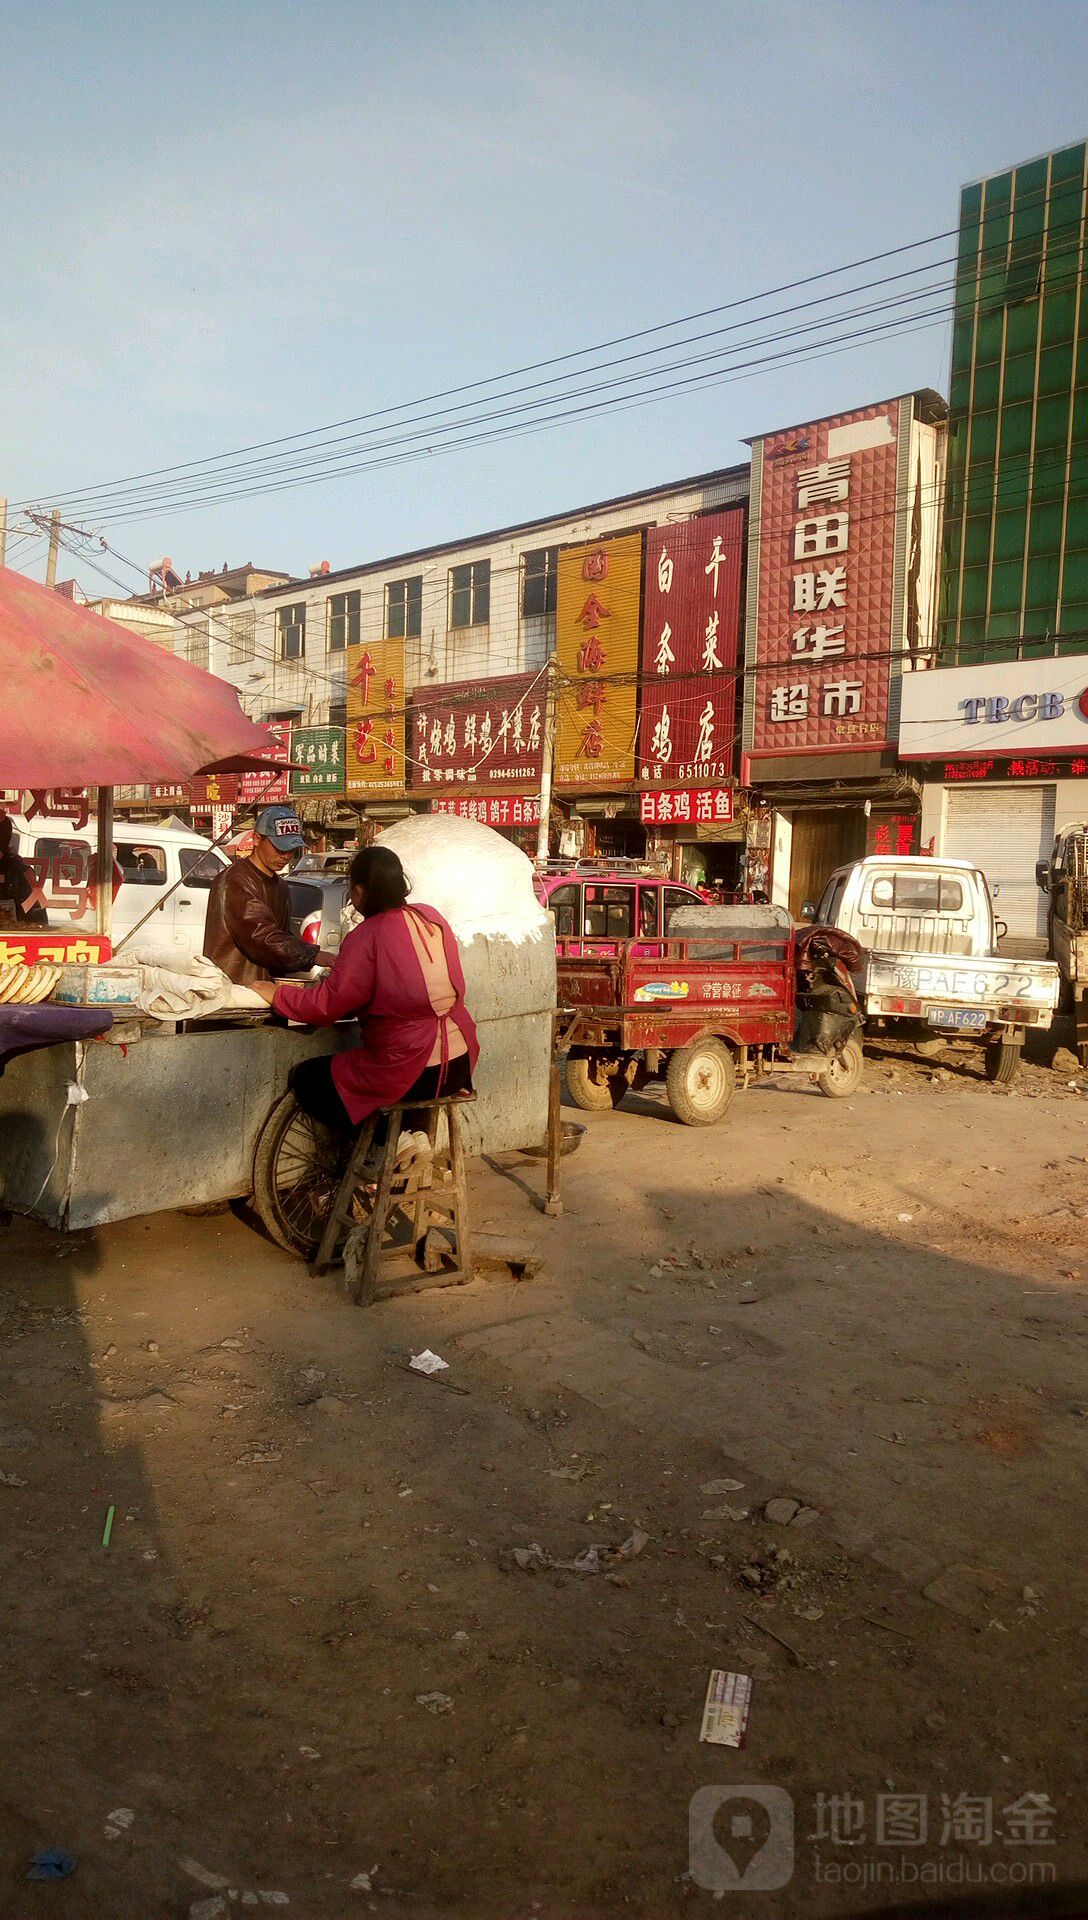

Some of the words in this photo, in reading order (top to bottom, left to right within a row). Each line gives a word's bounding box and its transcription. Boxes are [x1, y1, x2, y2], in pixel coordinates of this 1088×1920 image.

[792, 459, 852, 664] 青田联华
[651, 545, 675, 763] 白条鸡
[694, 535, 726, 763] 干菜店
[771, 679, 863, 722] 超市
[958, 692, 1065, 725] TRCB
[417, 712, 429, 765] 许氏
[498, 705, 541, 755] 干菜店
[641, 764, 662, 780] 电话
[679, 762, 725, 779] 6511073
[490, 800, 510, 823] 鸽子
[641, 791, 690, 821] 白条鸡
[696, 790, 731, 820] 活鱼
[279, 824, 299, 834] TAKE
[22, 852, 88, 920] 鸡
